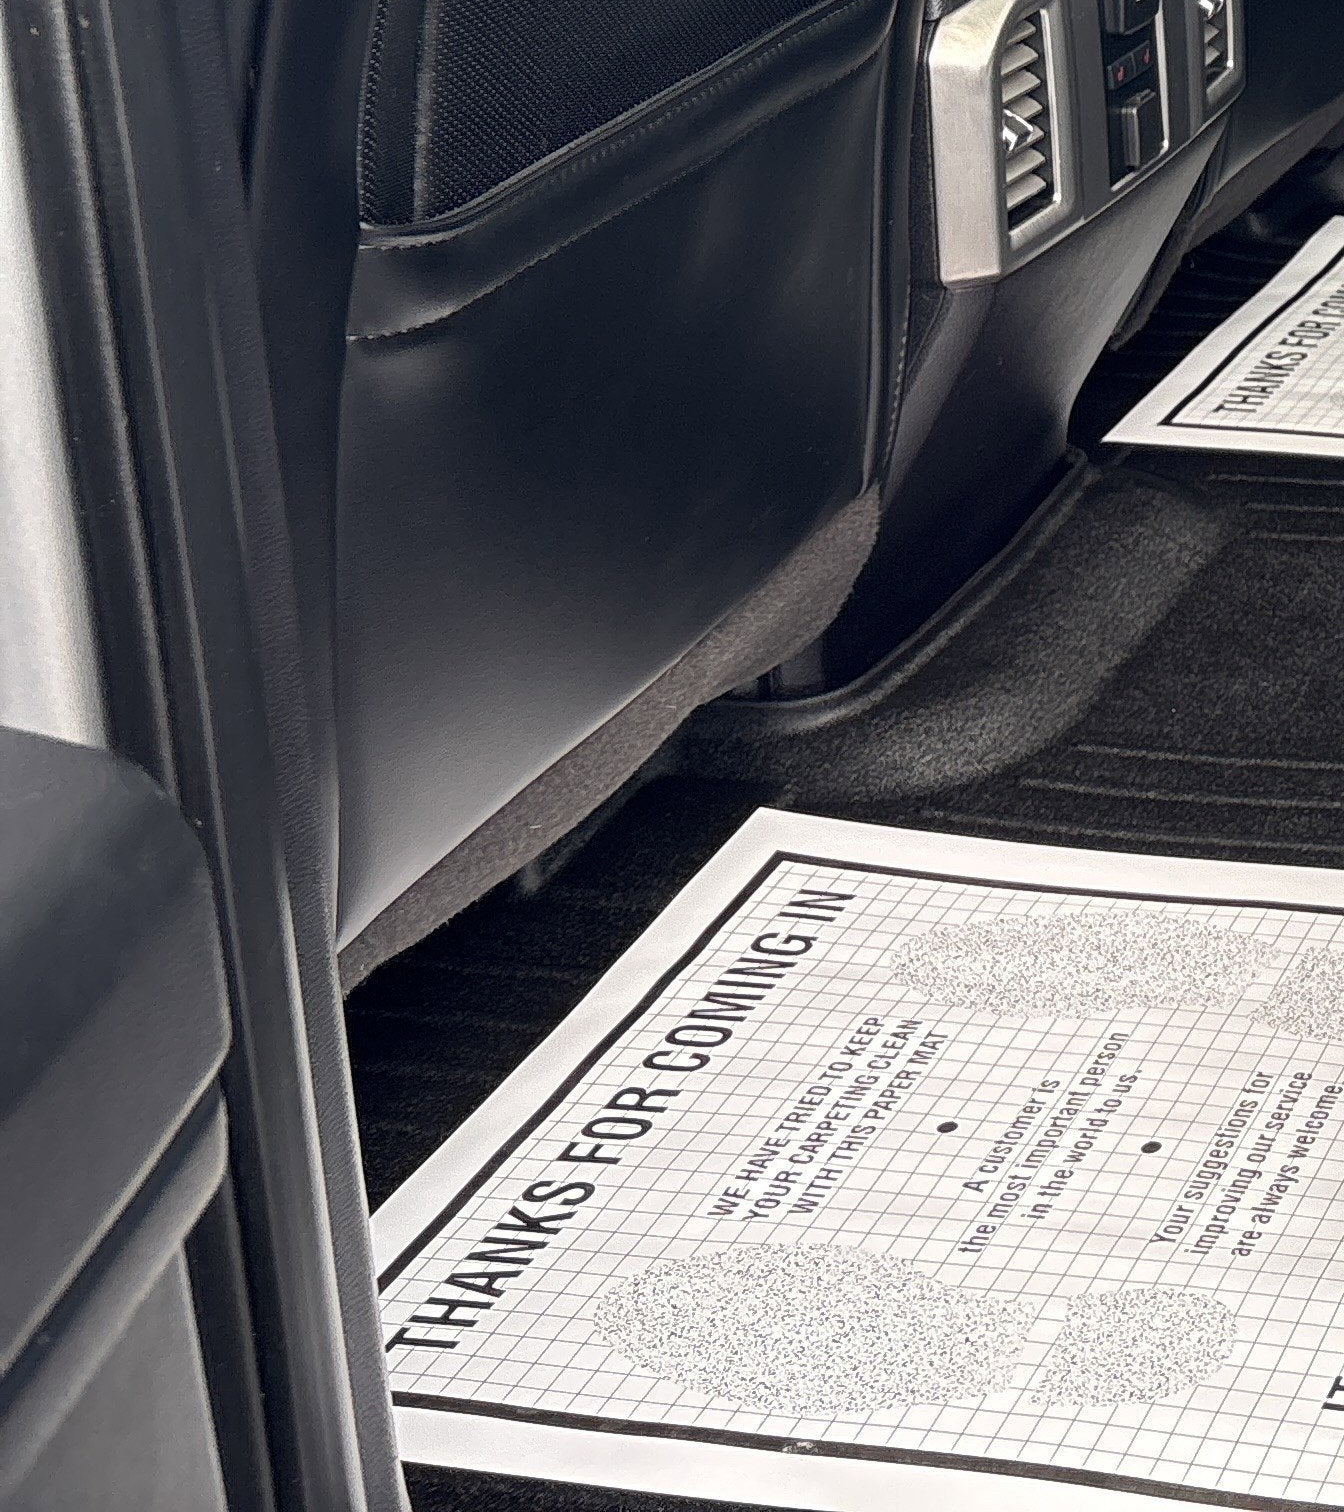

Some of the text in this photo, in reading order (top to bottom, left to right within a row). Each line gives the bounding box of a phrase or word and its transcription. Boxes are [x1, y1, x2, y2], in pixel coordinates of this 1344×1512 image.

[1212, 350, 1308, 413] THANKS
[1278, 320, 1341, 348] FOR
[385, 888, 857, 1352] THANKS FOR COMING IN
[707, 1017, 884, 1216] WE HAVE TRIED TO KEEP
[741, 1019, 923, 1221] YOUR CARPETING CLEAN
[787, 1029, 948, 1214] WITH THIS PAPER MAT
[958, 1032, 1129, 1253] the most important person
[962, 1079, 1061, 1193] A customer is
[1020, 1069, 1143, 1219] in the world to us.
[1149, 1071, 1274, 1243] Your suggestions for
[1184, 1071, 1313, 1255] improving our service
[1231, 1230, 1263, 1257] are
[1250, 1164, 1300, 1224] always
